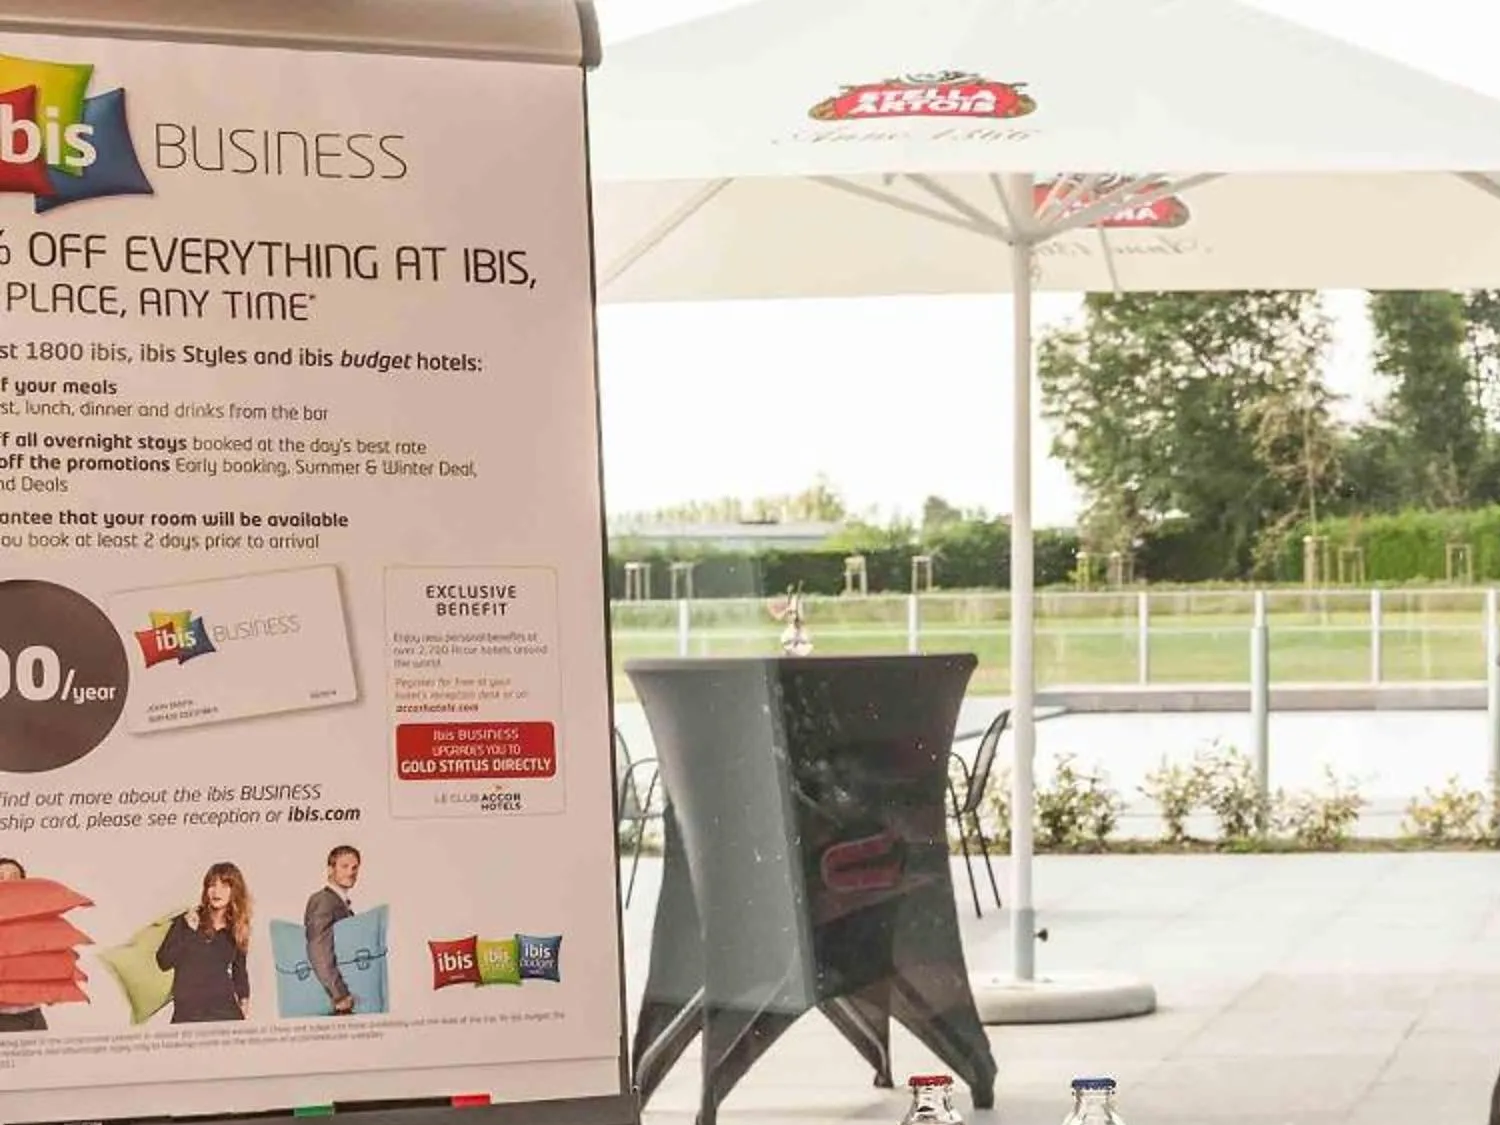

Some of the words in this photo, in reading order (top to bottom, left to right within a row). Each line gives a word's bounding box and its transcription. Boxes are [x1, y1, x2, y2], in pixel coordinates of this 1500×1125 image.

[860, 88, 997, 102] STELLA
[849, 98, 997, 114] ARTOIS
[155, 123, 408, 180] BUSINESS
[29, 231, 107, 269] OFF
[125, 235, 378, 280] EVERYTHING
[396, 246, 446, 282] AT
[464, 248, 538, 290] IBIS,
[7, 281, 126, 319] PLACE,
[140, 287, 209, 319] ANY
[26, 342, 83, 361] 1800
[91, 342, 133, 365] ibis,
[140, 343, 176, 363] ibis
[183, 345, 247, 368] Styles
[254, 347, 292, 366] and
[299, 348, 333, 367] ibis
[340, 350, 413, 373] budget
[417, 352, 483, 373] hotels:
[15, 379, 57, 397] your
[63, 379, 117, 395] meals
[25, 400, 76, 418] lunch,
[79, 401, 132, 417] dinner
[138, 402, 169, 418] and
[174, 402, 225, 419] drinks
[229, 403, 267, 420] from
[271, 405, 299, 421] the
[303, 406, 328, 421] bar
[16, 432, 37, 448] all
[43, 434, 133, 452] overnight
[138, 435, 187, 453] stays
[192, 436, 252, 451] booked
[257, 438, 273, 452] at
[279, 437, 305, 452] the
[310, 438, 351, 456] day's
[356, 439, 390, 454] best
[395, 442, 427, 455] rate
[29, 454, 61, 470] the
[67, 455, 170, 474] promotions
[175, 457, 217, 476] Early
[295, 459, 360, 475] Summer
[365, 460, 377, 475] &
[382, 459, 434, 476] Winter
[21, 476, 68, 493] Deals
[59, 510, 98, 525] that
[103, 512, 145, 529] your
[151, 512, 197, 527] room
[202, 511, 235, 527] will
[240, 511, 262, 527] be
[267, 511, 349, 528] available
[28, 531, 70, 548] book
[75, 533, 92, 548] at
[97, 532, 138, 548] least
[143, 532, 154, 548] 2
[159, 532, 200, 551] days
[205, 533, 241, 551] prior
[247, 533, 264, 549] to
[269, 533, 319, 549] arrival
[425, 585, 517, 599] EXCLUSIVE
[436, 602, 508, 617] BENEFIT
[155, 628, 198, 653] ibis
[213, 614, 302, 644] BUSINESS
[458, 728, 519, 742] BUSINESS
[401, 760, 436, 774] GOLD
[439, 758, 489, 773] STATUS
[493, 757, 552, 772] DIRECTLY
[35, 792, 64, 806] out
[69, 792, 112, 806] more
[119, 788, 166, 805] about
[173, 788, 201, 803] the
[207, 785, 235, 801] ibis
[240, 783, 322, 801] BUSINESS
[41, 813, 81, 830] card,
[86, 810, 141, 831] please
[148, 812, 177, 827] see
[183, 808, 261, 828] reception
[265, 811, 281, 825] or
[288, 805, 361, 824] ibis.com
[437, 949, 473, 974] ibis
[525, 943, 551, 960] ibis
